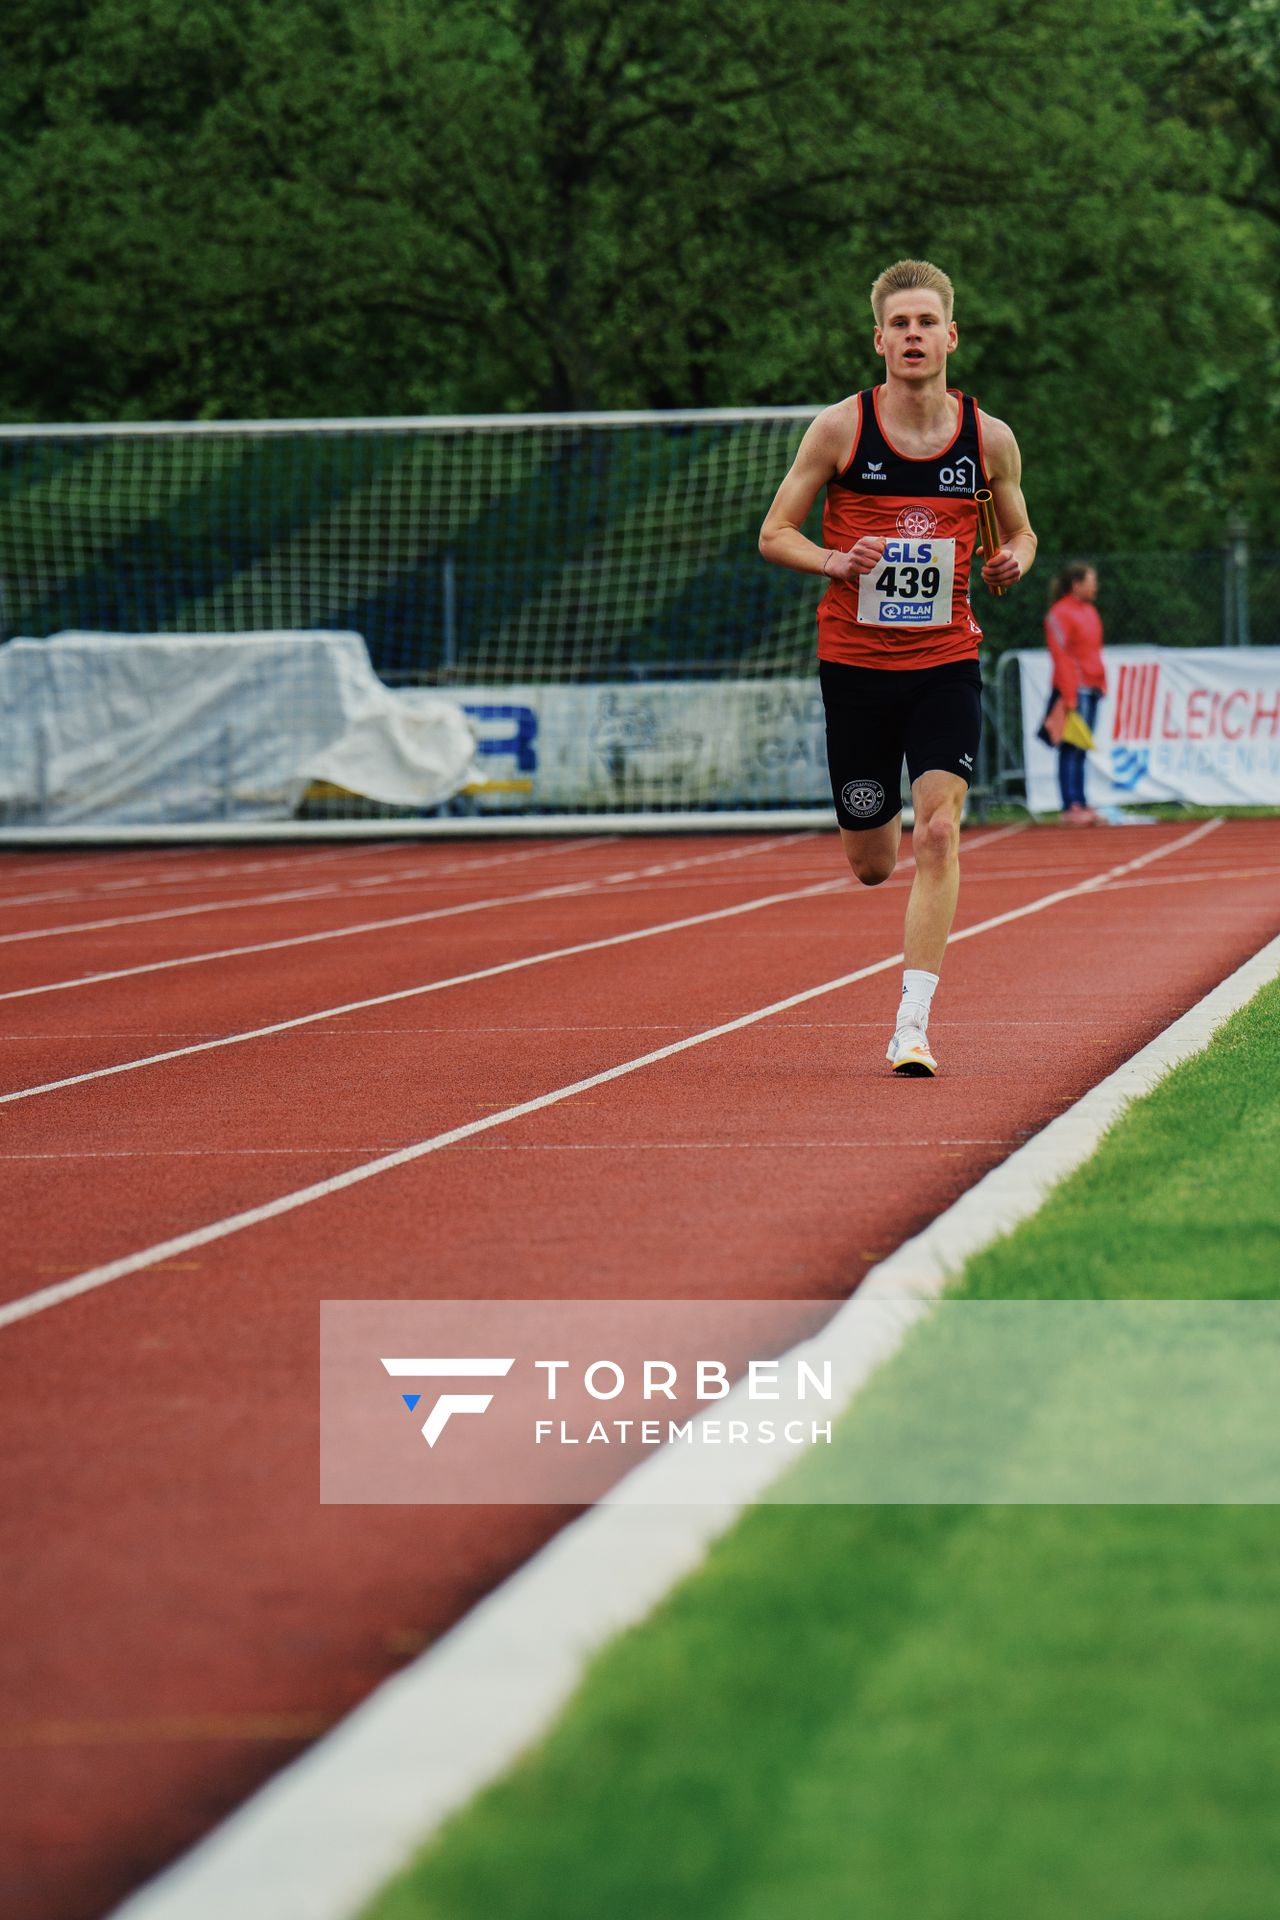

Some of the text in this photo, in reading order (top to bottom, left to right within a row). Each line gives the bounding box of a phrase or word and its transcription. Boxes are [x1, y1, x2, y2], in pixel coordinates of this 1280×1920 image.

[861, 472, 887, 481] erima
[939, 467, 966, 485] OS
[876, 566, 941, 599] 439
[903, 605, 932, 615] PLAN
[1162, 688, 1280, 740] LEICH
